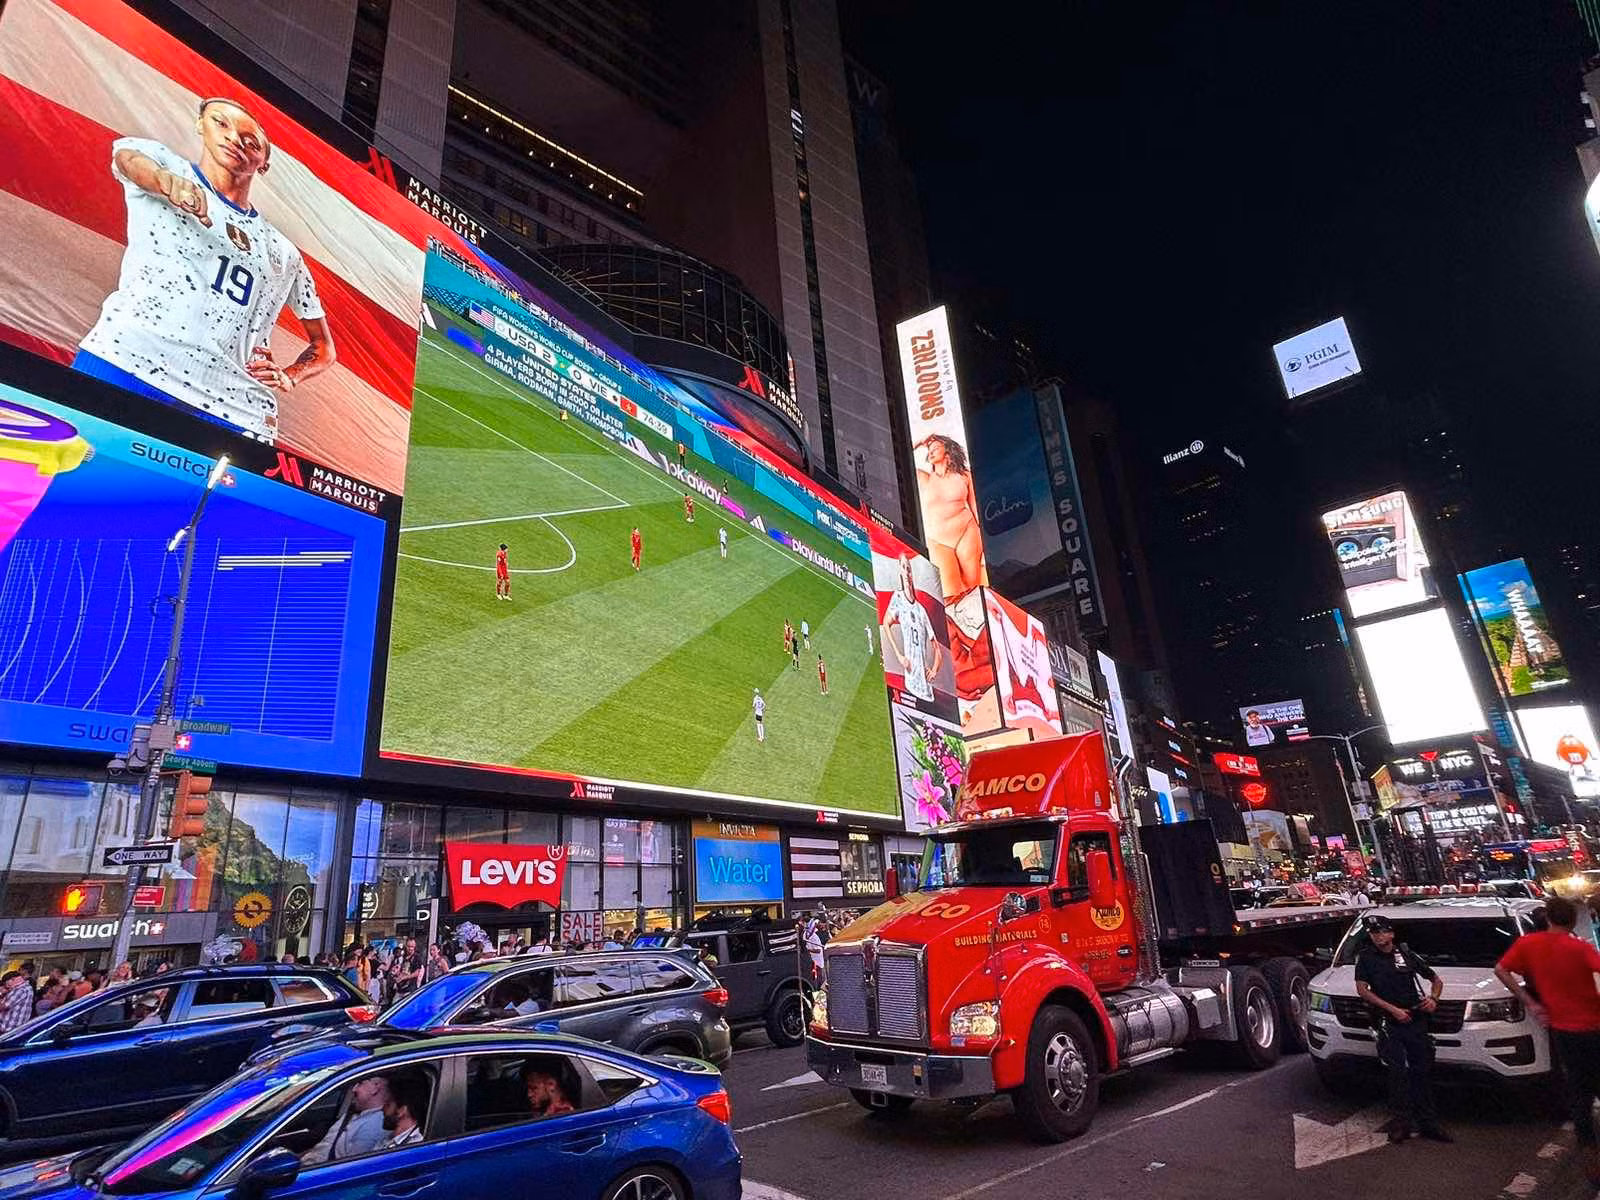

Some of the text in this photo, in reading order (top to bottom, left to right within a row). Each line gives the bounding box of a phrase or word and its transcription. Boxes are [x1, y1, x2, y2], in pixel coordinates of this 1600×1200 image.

[407, 189, 478, 245] MARQUIS
[409, 177, 488, 239] MARRIOTT
[210, 255, 254, 306] 19
[508, 328, 537, 354] USA
[542, 349, 552, 363] 2
[589, 378, 608, 398] VIE
[1305, 343, 1339, 364] PGIM
[487, 343, 494, 354] 4
[495, 348, 534, 377] PLAYERS
[536, 373, 558, 392] BORN
[569, 392, 589, 411] 2000
[590, 404, 601, 417] OR
[601, 410, 623, 430] LATER
[522, 353, 597, 405] UNITED STATES
[911, 329, 945, 421] SMOOTHEZ
[585, 411, 625, 441] THOMPSON
[130, 441, 217, 480] swatch
[311, 480, 376, 511] MARQUIS
[313, 467, 386, 502] MARRIOTT
[984, 496, 1030, 522] Calm
[1326, 499, 1404, 529] SAMSUNG
[1058, 498, 1094, 617] SQUARE
[67, 723, 129, 743] swa
[183, 722, 227, 735] Broadway
[165, 754, 190, 766] George
[1399, 755, 1473, 777] WE NYC
[957, 773, 1046, 800] KAMCO
[849, 832, 869, 841] SEPHORA
[114, 850, 164, 860] ONE WAY
[710, 857, 771, 884] Water
[847, 881, 884, 894] SEPHORA
[563, 913, 600, 929] SALE
[954, 930, 1038, 946] BUILDING MATERIALS
